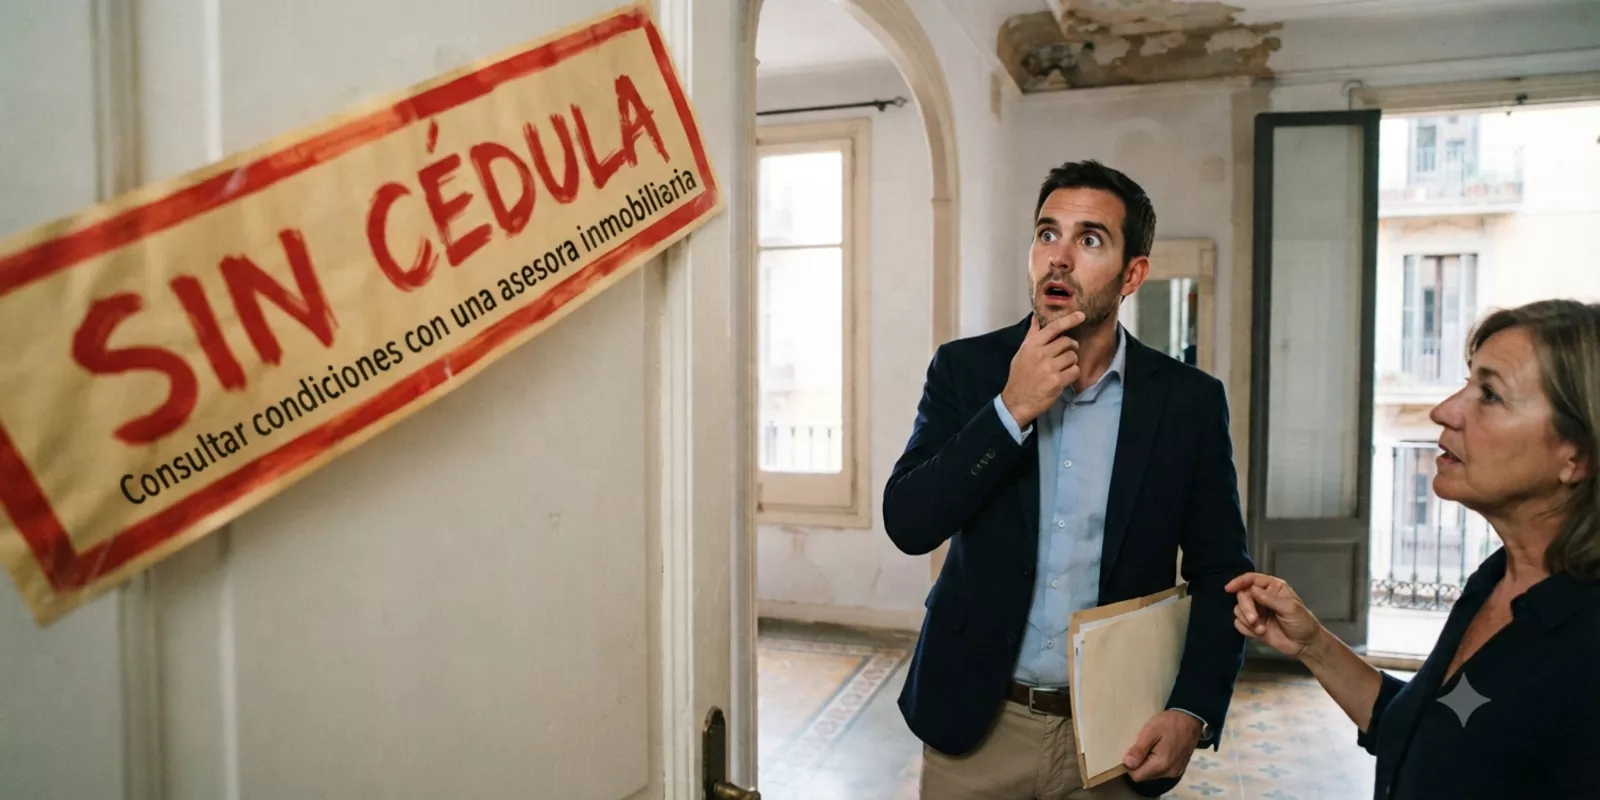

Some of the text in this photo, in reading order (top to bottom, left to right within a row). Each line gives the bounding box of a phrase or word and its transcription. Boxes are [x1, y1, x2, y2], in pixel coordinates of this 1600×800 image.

[71, 75, 670, 446] SIN CÉDULA
[120, 168, 697, 504] Consultar condiciones con una asesora inmobiliaria
